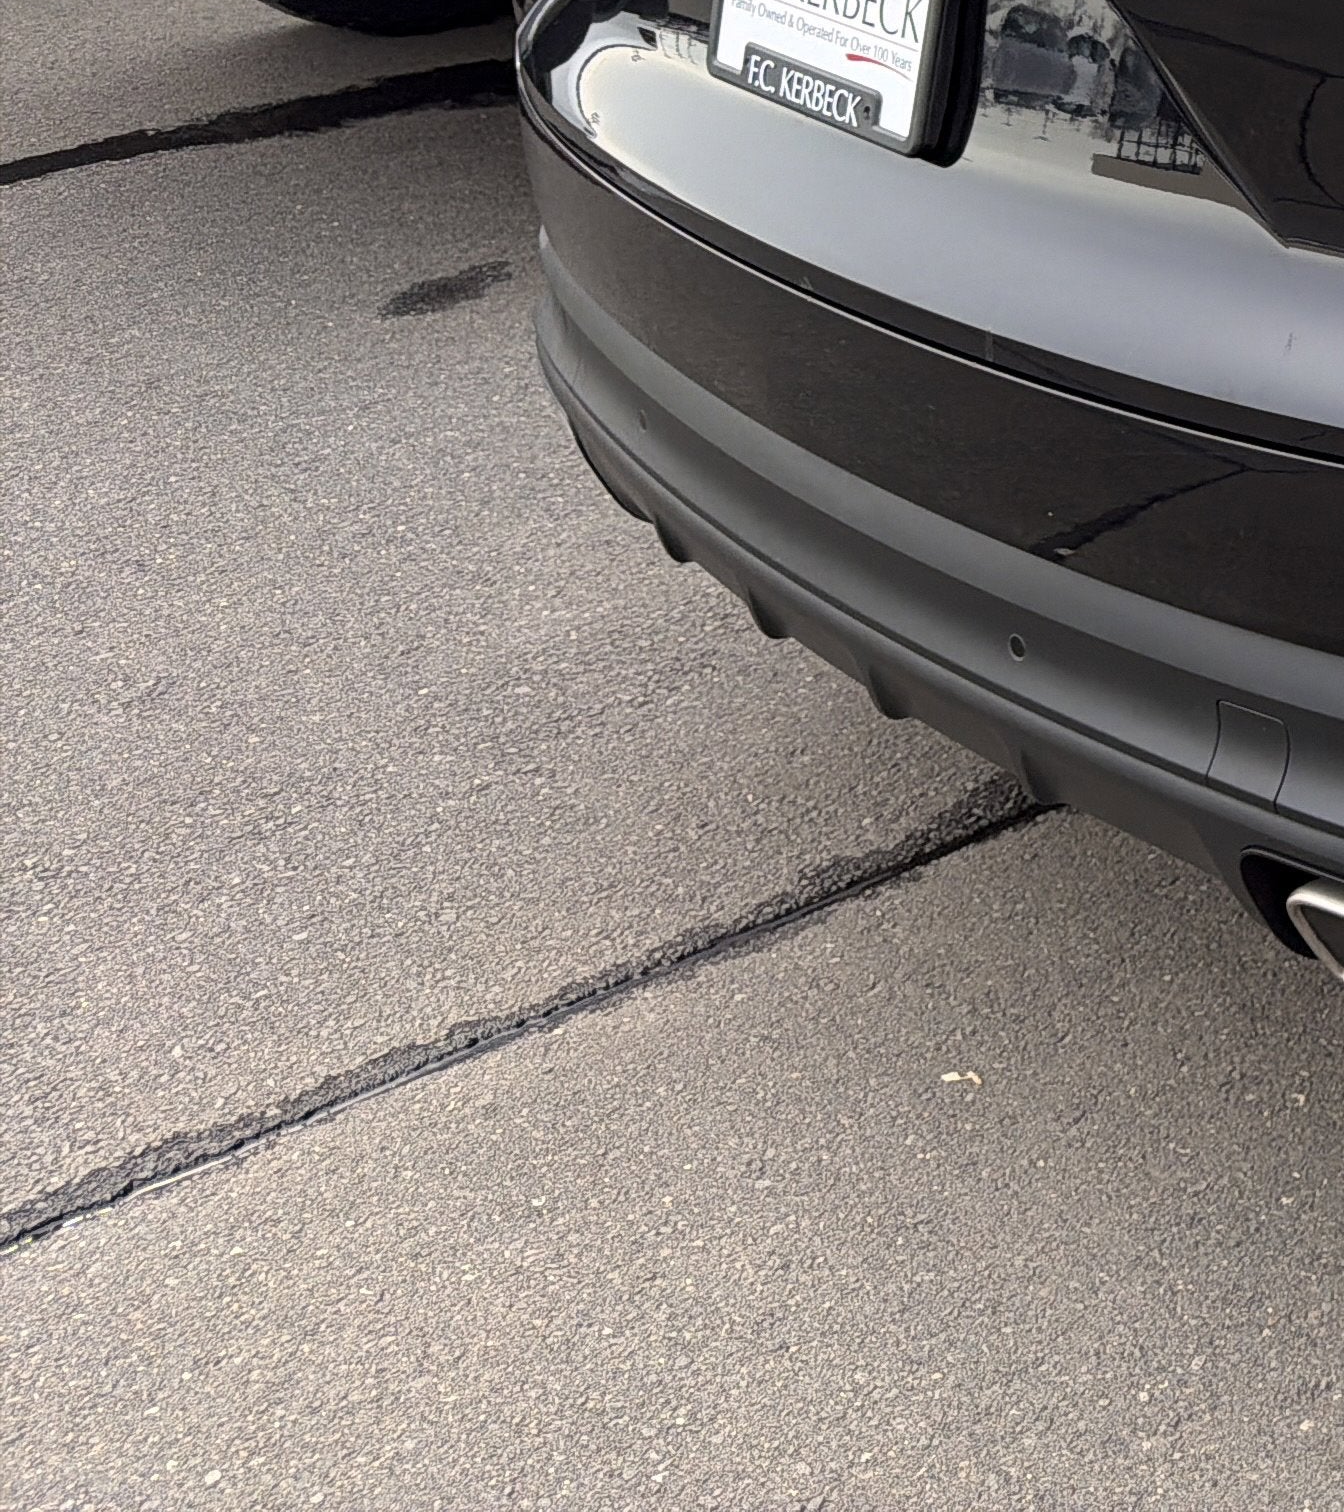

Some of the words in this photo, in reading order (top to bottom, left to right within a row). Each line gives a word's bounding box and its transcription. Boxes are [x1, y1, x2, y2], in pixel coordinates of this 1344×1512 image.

[758, 2, 787, 25] Owned
[787, 14, 795, 28] &
[796, 16, 835, 43] Operated
[835, 30, 849, 48] For
[850, 36, 871, 55] Over
[873, 44, 889, 62] 100
[891, 50, 912, 72] Years
[747, 54, 776, 93] F.C.
[779, 66, 862, 128] KERBECK
